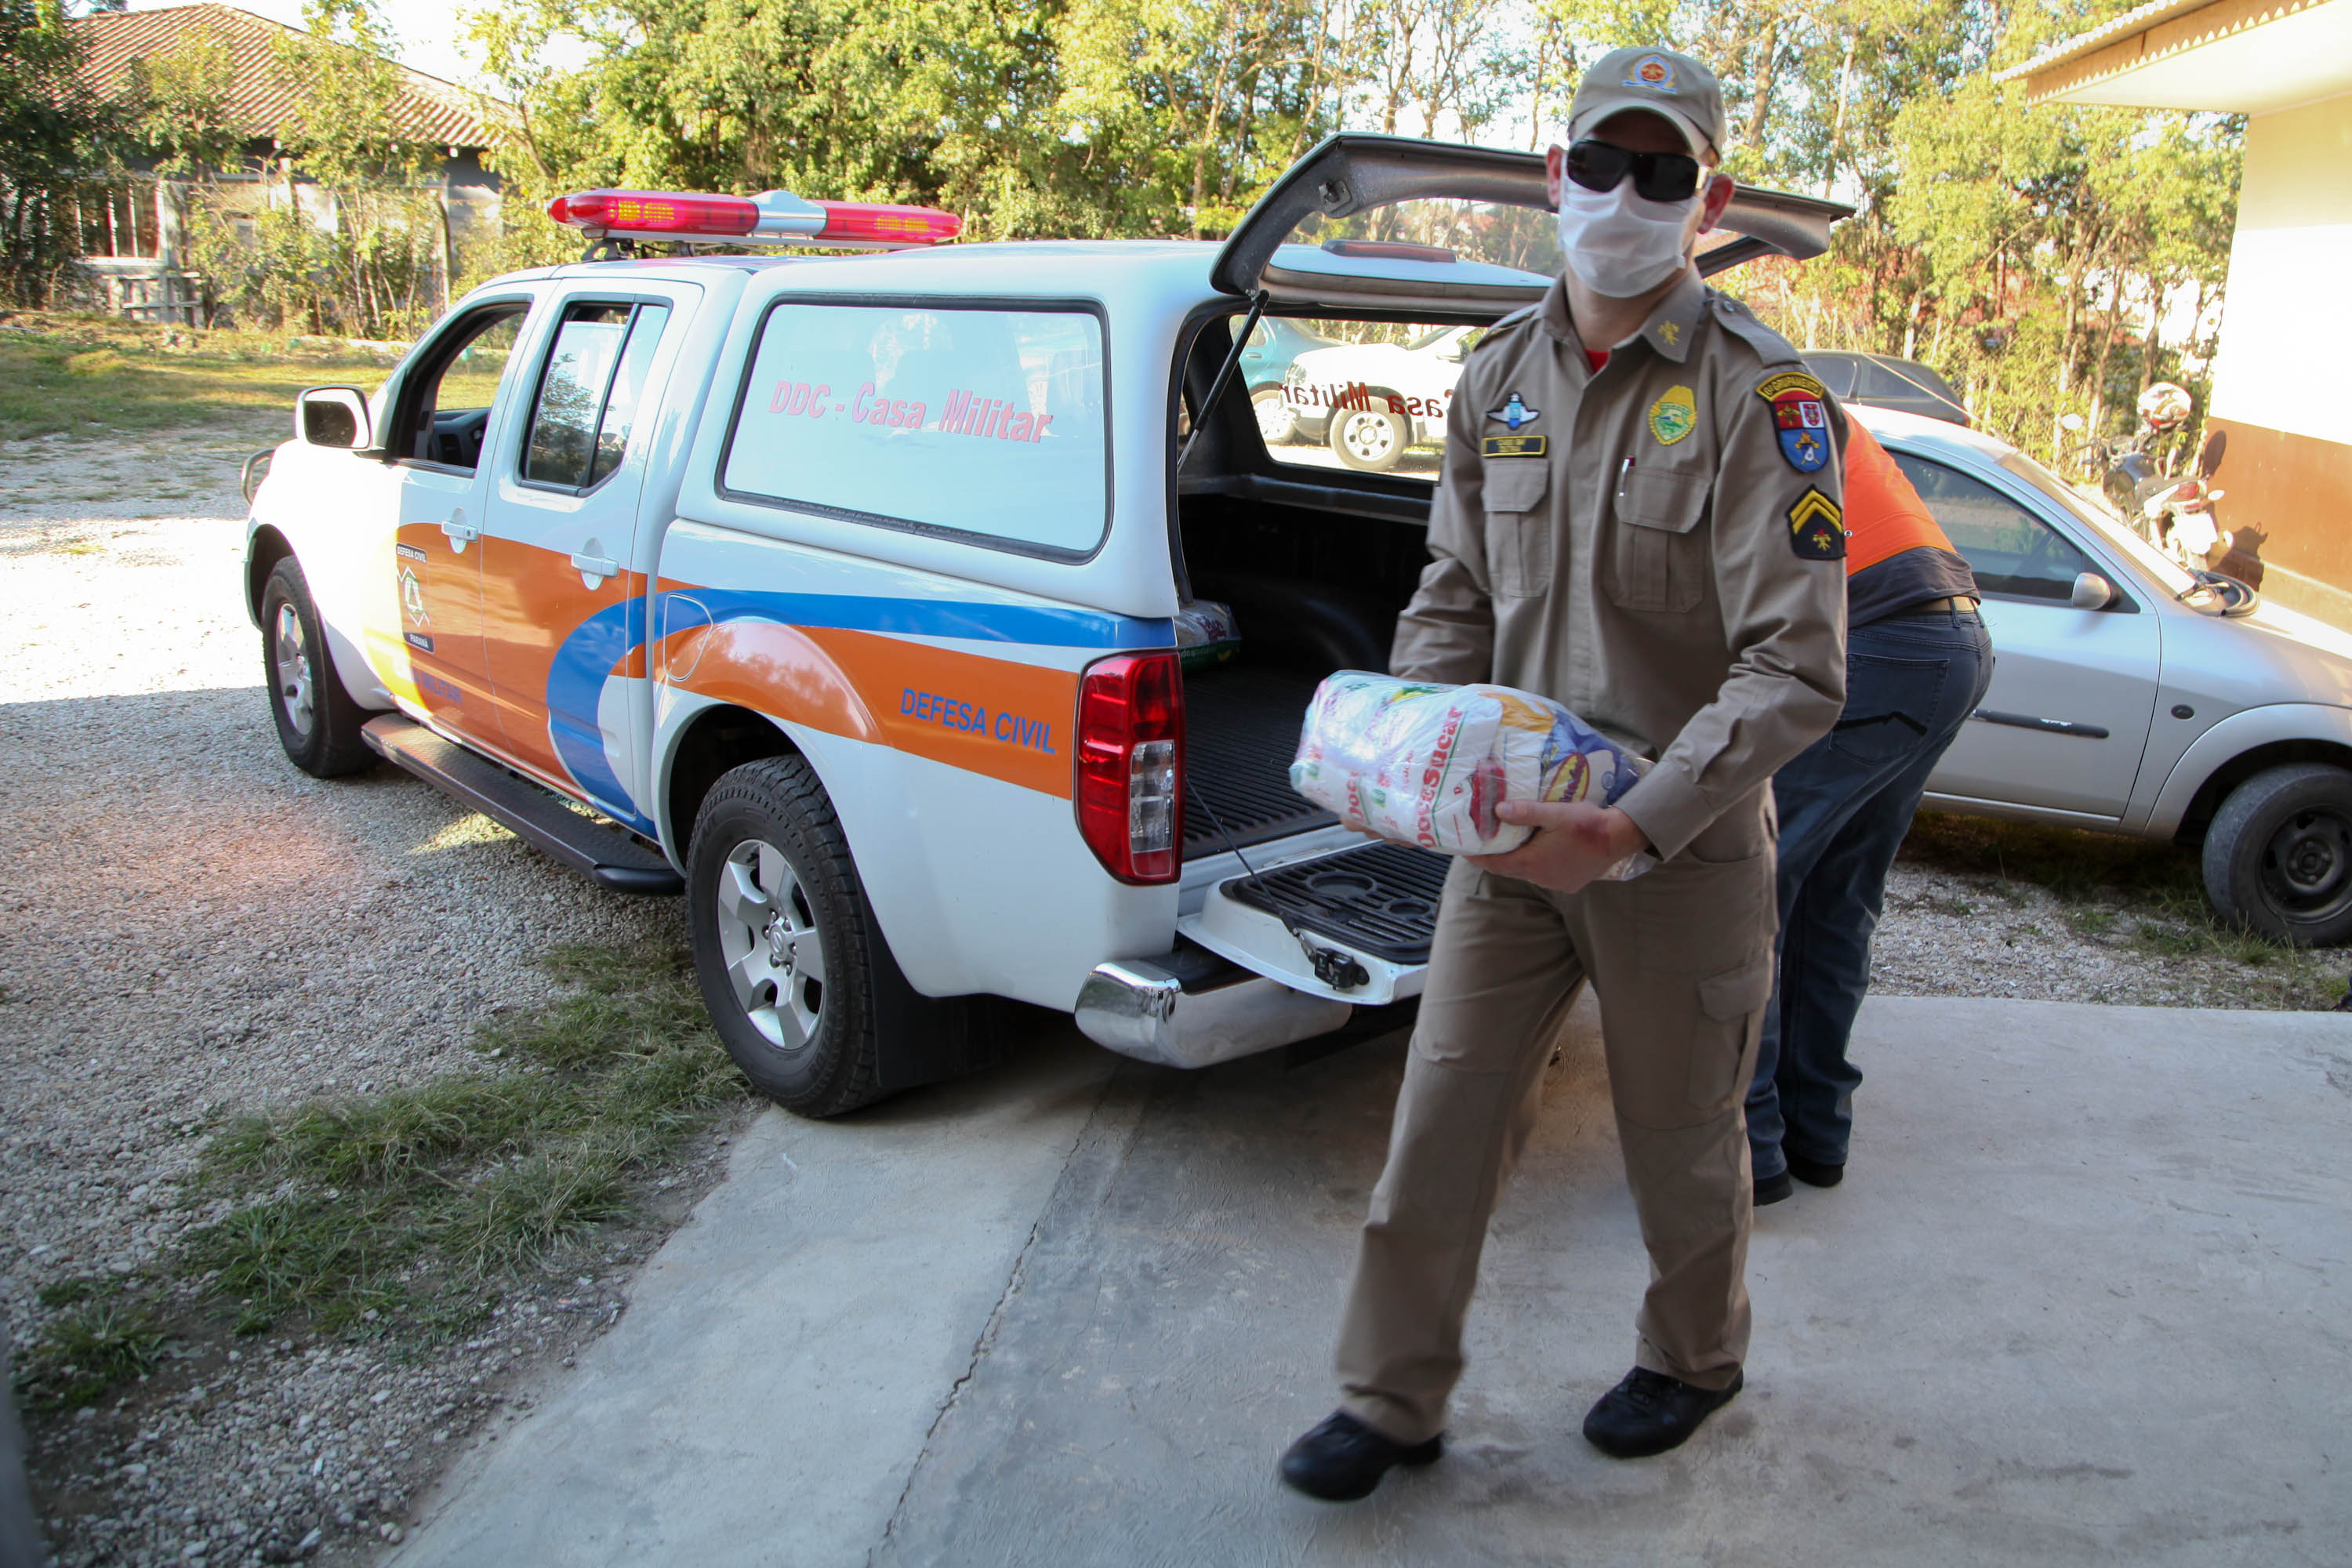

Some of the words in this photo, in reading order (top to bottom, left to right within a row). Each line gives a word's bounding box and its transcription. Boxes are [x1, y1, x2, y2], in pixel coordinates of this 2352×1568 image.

[769, 381, 830, 418] DDC
[852, 382, 927, 429] Casa
[938, 388, 1054, 444] Militar
[397, 546, 414, 559] DEFESA
[414, 551, 427, 564] CIVIL
[900, 688, 986, 736] DEFESA
[995, 712, 1056, 755] CIVIL
